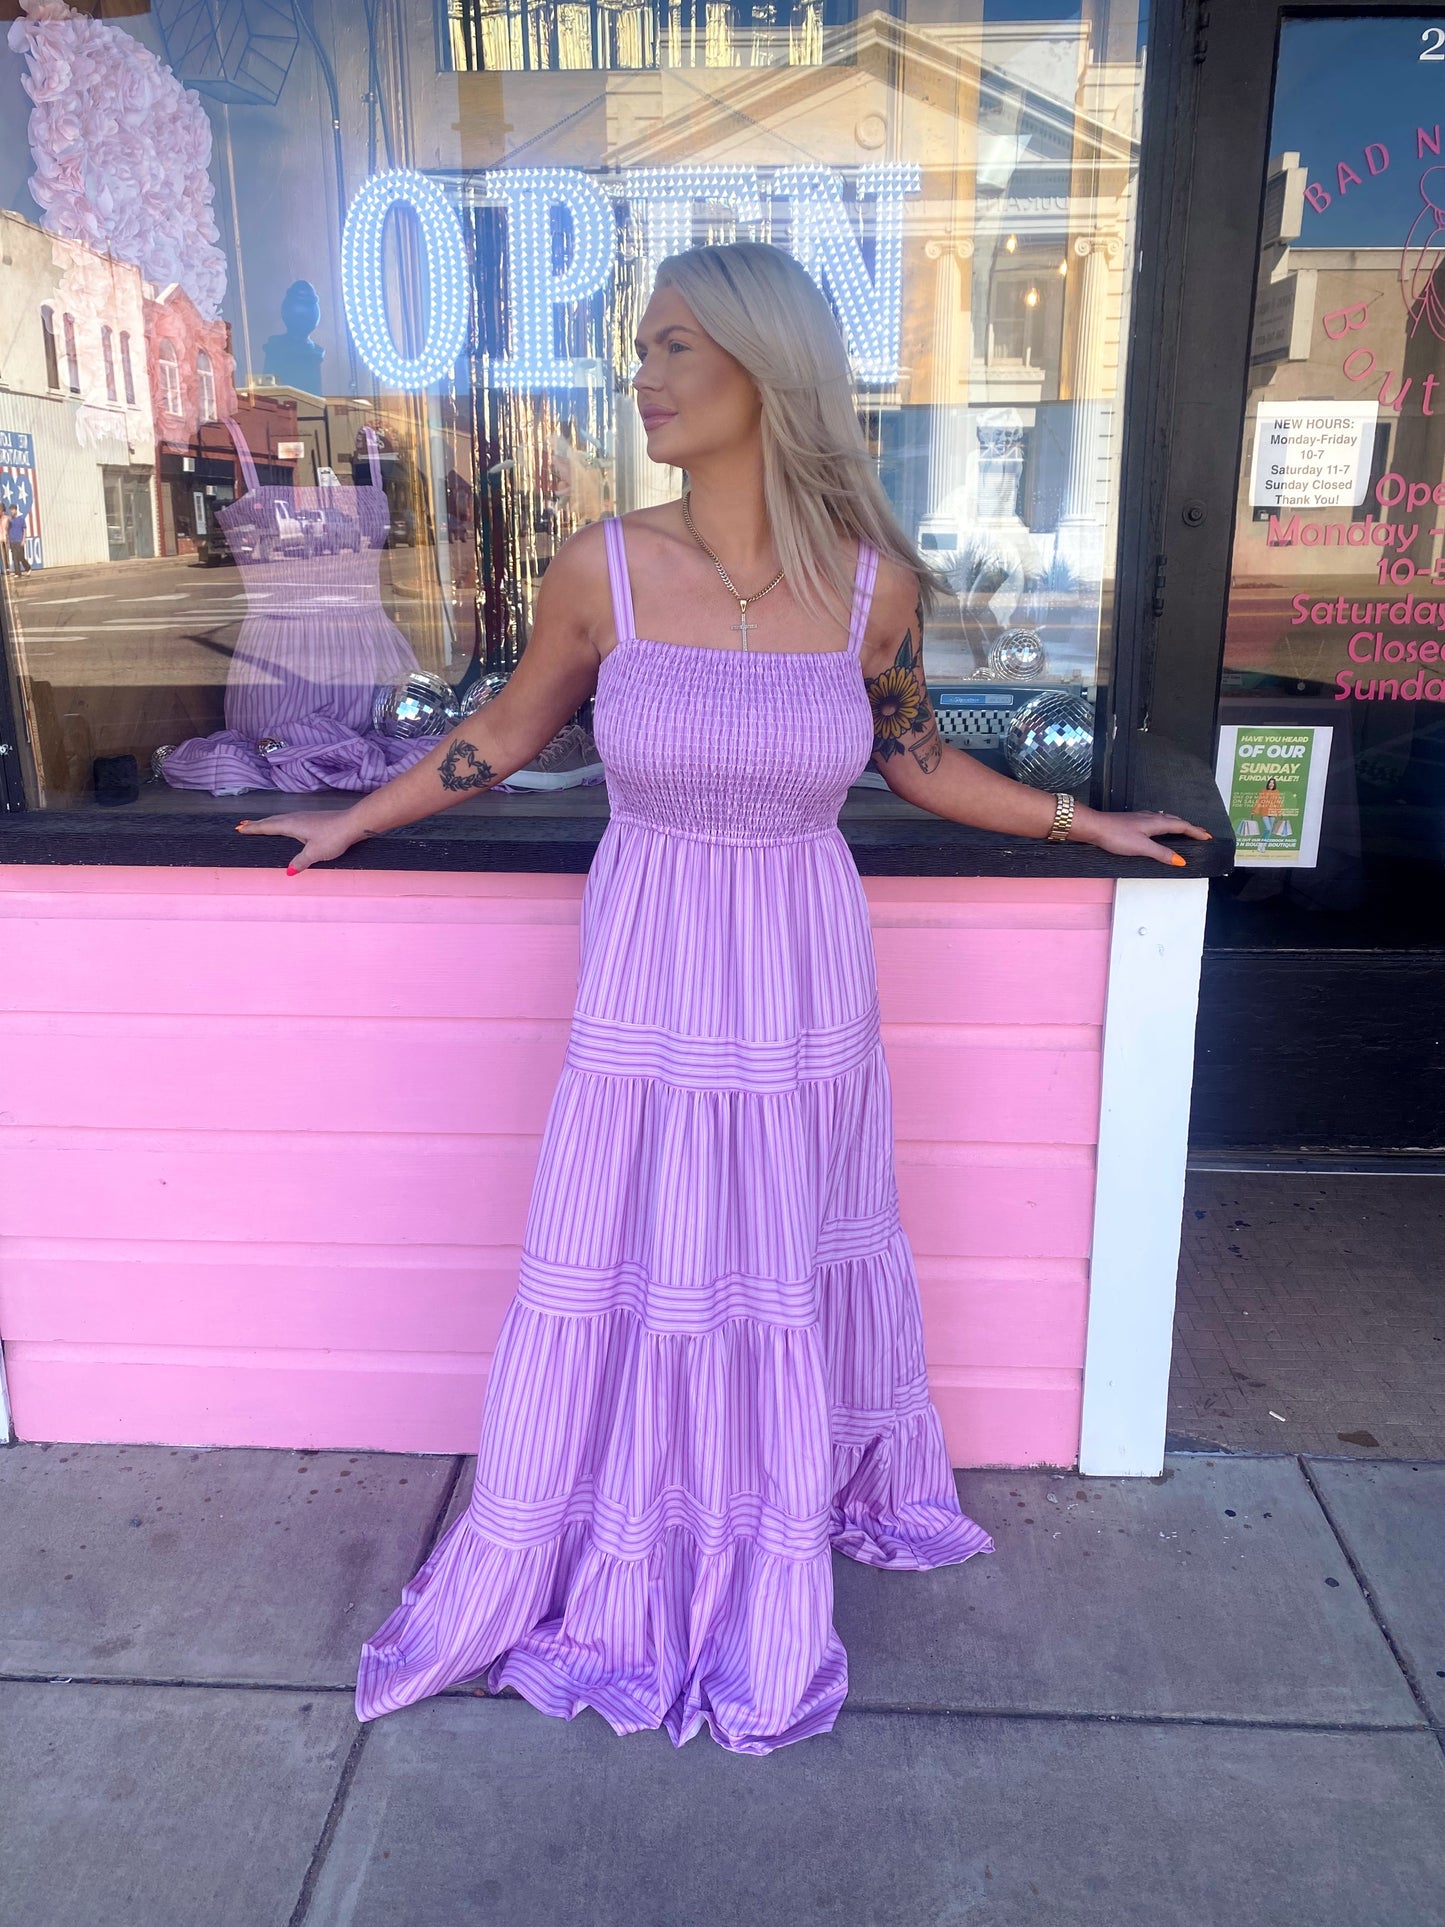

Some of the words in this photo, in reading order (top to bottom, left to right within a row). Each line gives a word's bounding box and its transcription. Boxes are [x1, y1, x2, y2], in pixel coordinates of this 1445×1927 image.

[1303, 143, 1390, 213] BAD
[1416, 124, 1440, 159] N
[1274, 419, 1303, 429] NEW
[1306, 418, 1355, 429] HOURS:
[1270, 434, 1358, 446] Monday-Friday
[1300, 449, 1325, 460] 10-7
[1271, 464, 1323, 477] Saturday
[1327, 464, 1351, 475] 11-7
[1265, 479, 1309, 492] Sunday
[1312, 479, 1353, 490] Closed
[1275, 494, 1310, 505] Thank
[1314, 494, 1340, 505] You!
[1266, 514, 1419, 553] Monday
[1347, 631, 1445, 664] Close
[1241, 735, 1264, 743] HAVE
[1238, 744, 1266, 758] OF
[1266, 744, 1306, 758] OUR
[1239, 762, 1301, 774] SUNDAY
[1239, 774, 1272, 782] FUNDAY
